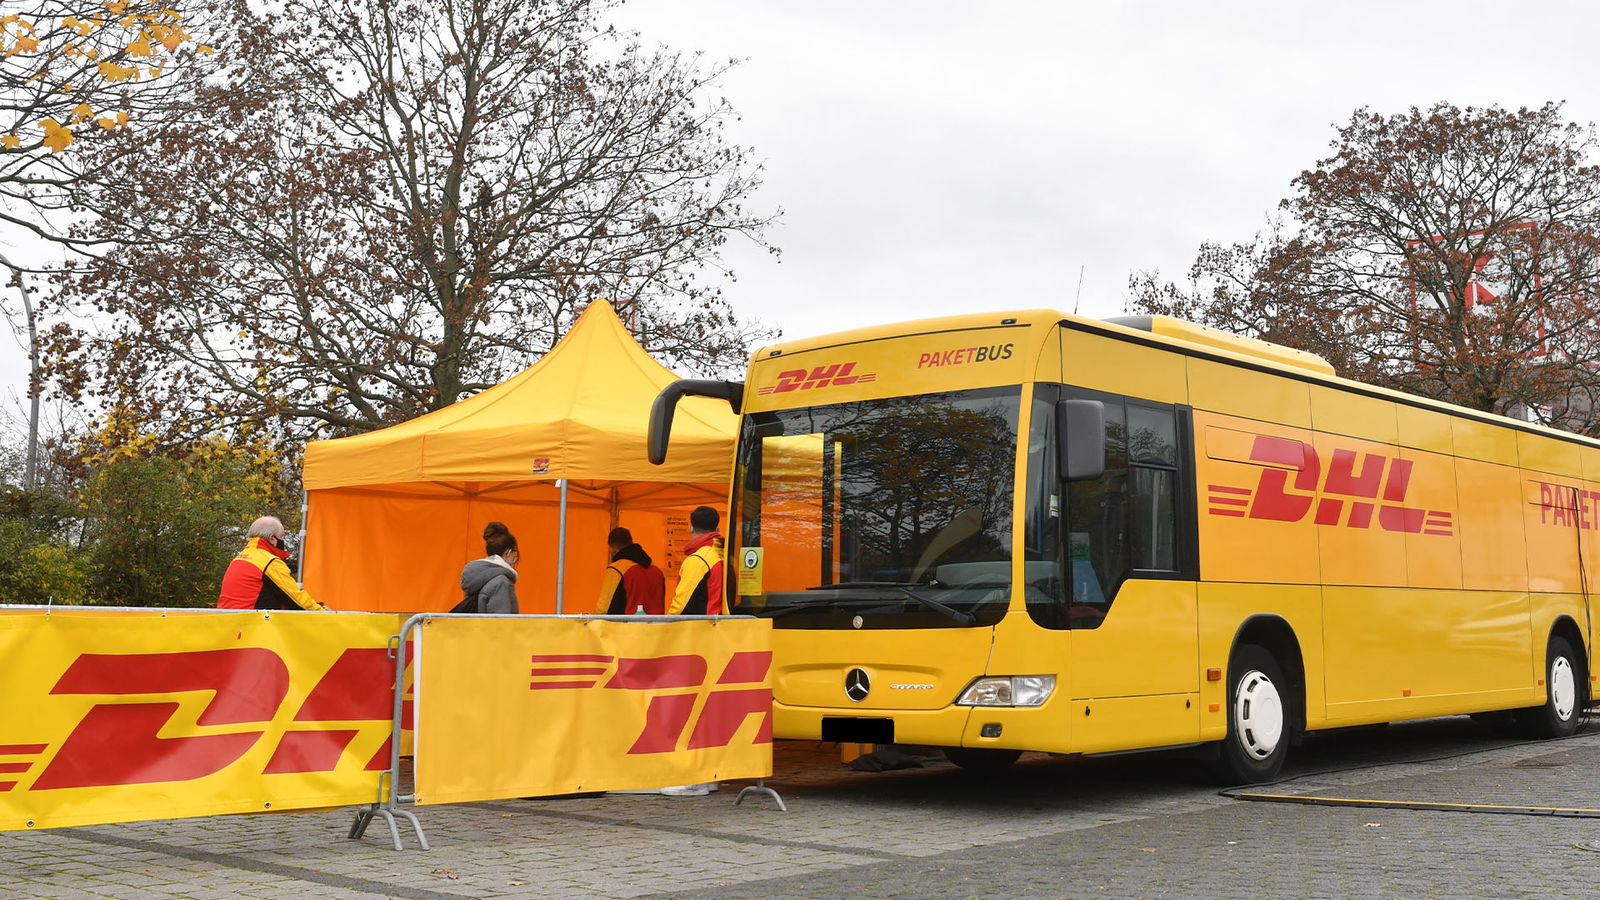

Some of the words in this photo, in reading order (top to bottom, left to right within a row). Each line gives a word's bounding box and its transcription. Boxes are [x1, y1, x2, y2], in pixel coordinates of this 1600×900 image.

[772, 362, 858, 394] DHL
[918, 343, 1014, 369] PAKETBUS
[1248, 435, 1426, 534] DHL
[30, 646, 400, 791] DH
[604, 650, 773, 755] DH
